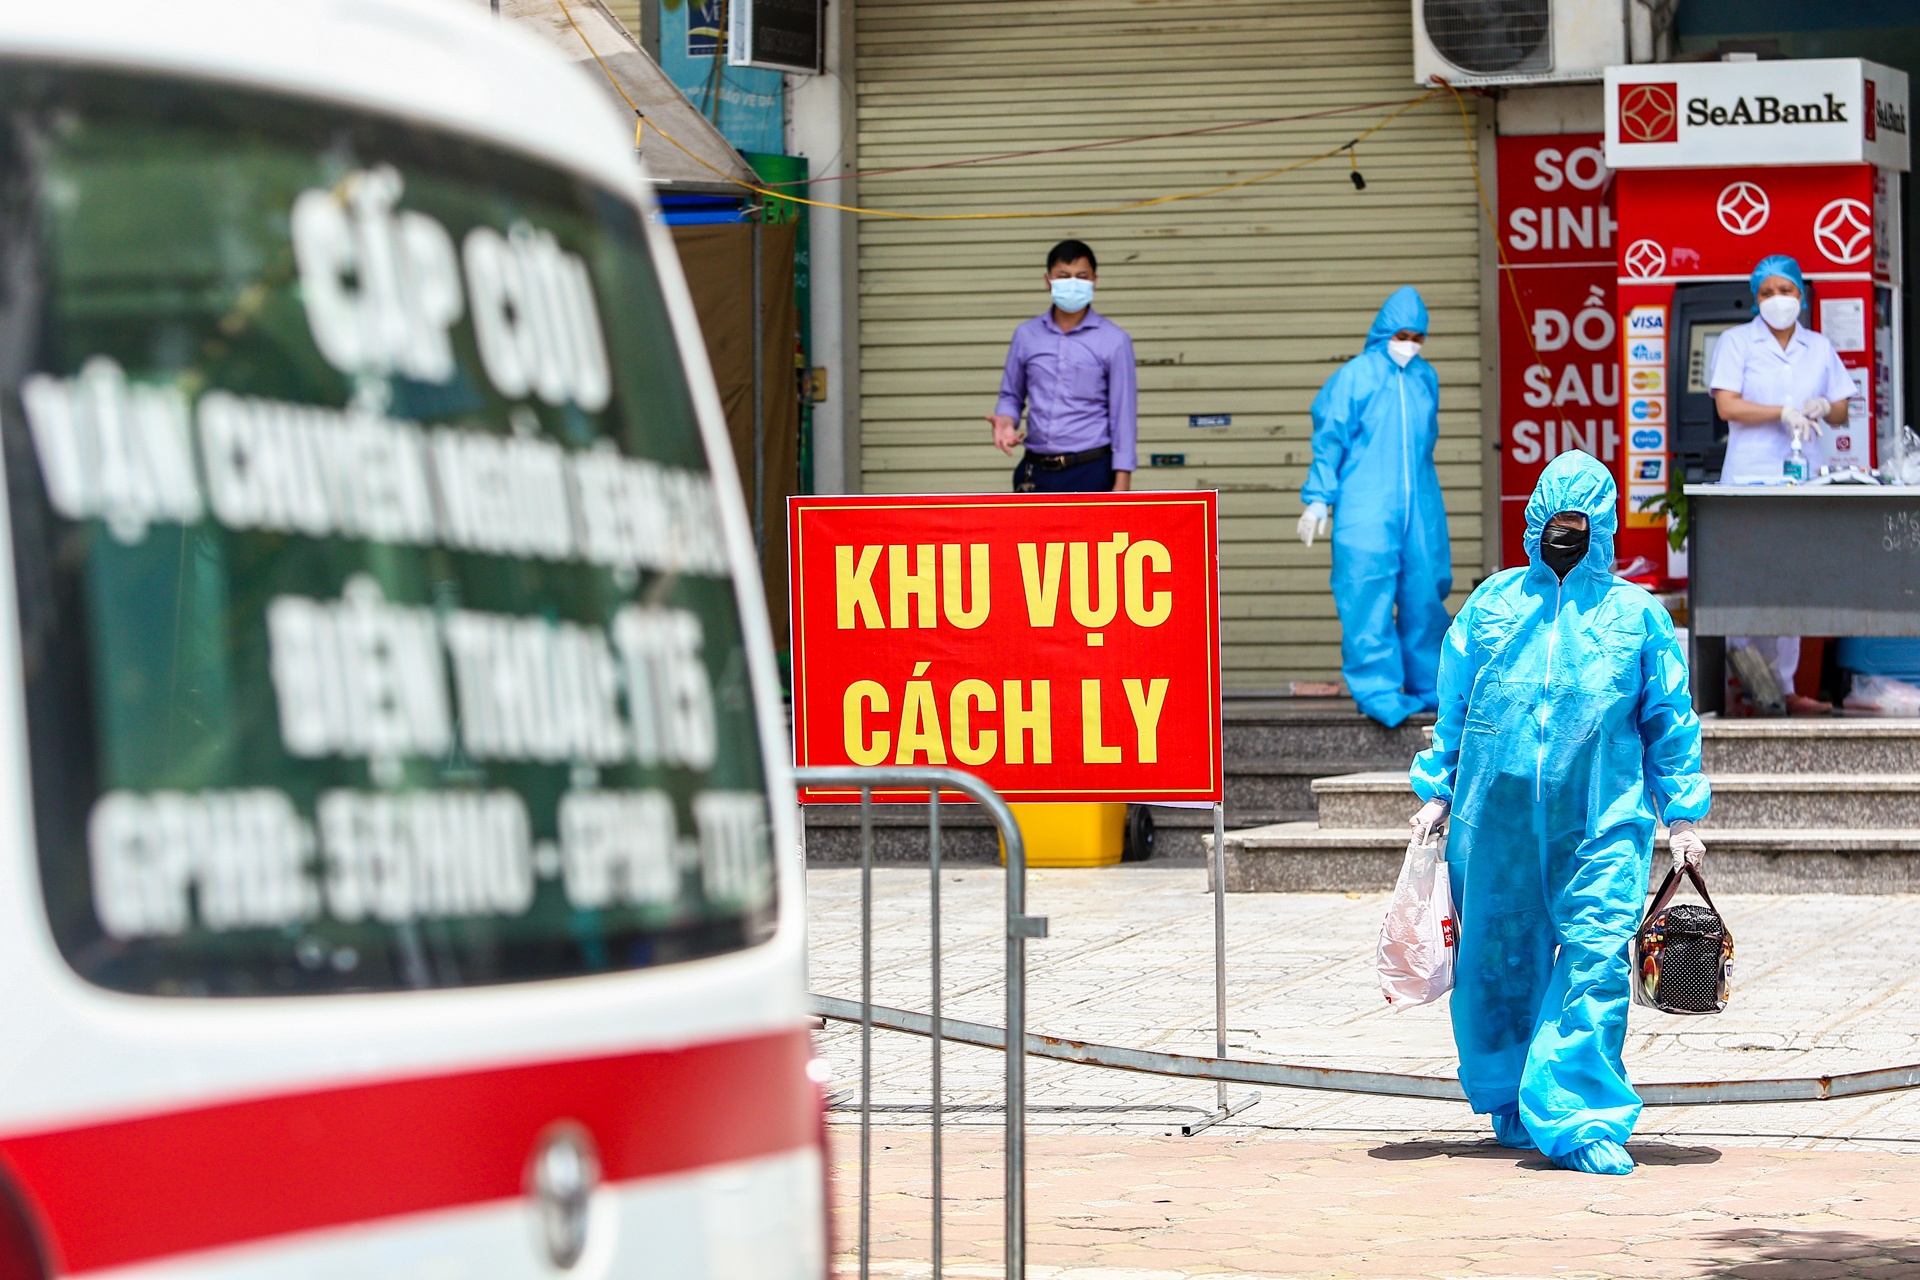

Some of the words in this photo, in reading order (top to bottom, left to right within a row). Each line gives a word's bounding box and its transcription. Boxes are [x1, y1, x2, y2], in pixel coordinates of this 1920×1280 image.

[1687, 93, 1848, 126] SeABank
[1876, 98, 1906, 134] SeABank
[1531, 284, 1616, 351] ĐỒ
[1631, 316, 1663, 329] VISA
[1523, 363, 1619, 408] SAU
[835, 543, 991, 630] KHU
[1017, 532, 1173, 647] VỰC
[842, 661, 1053, 766] CÁCH
[1081, 678, 1170, 764] LY
